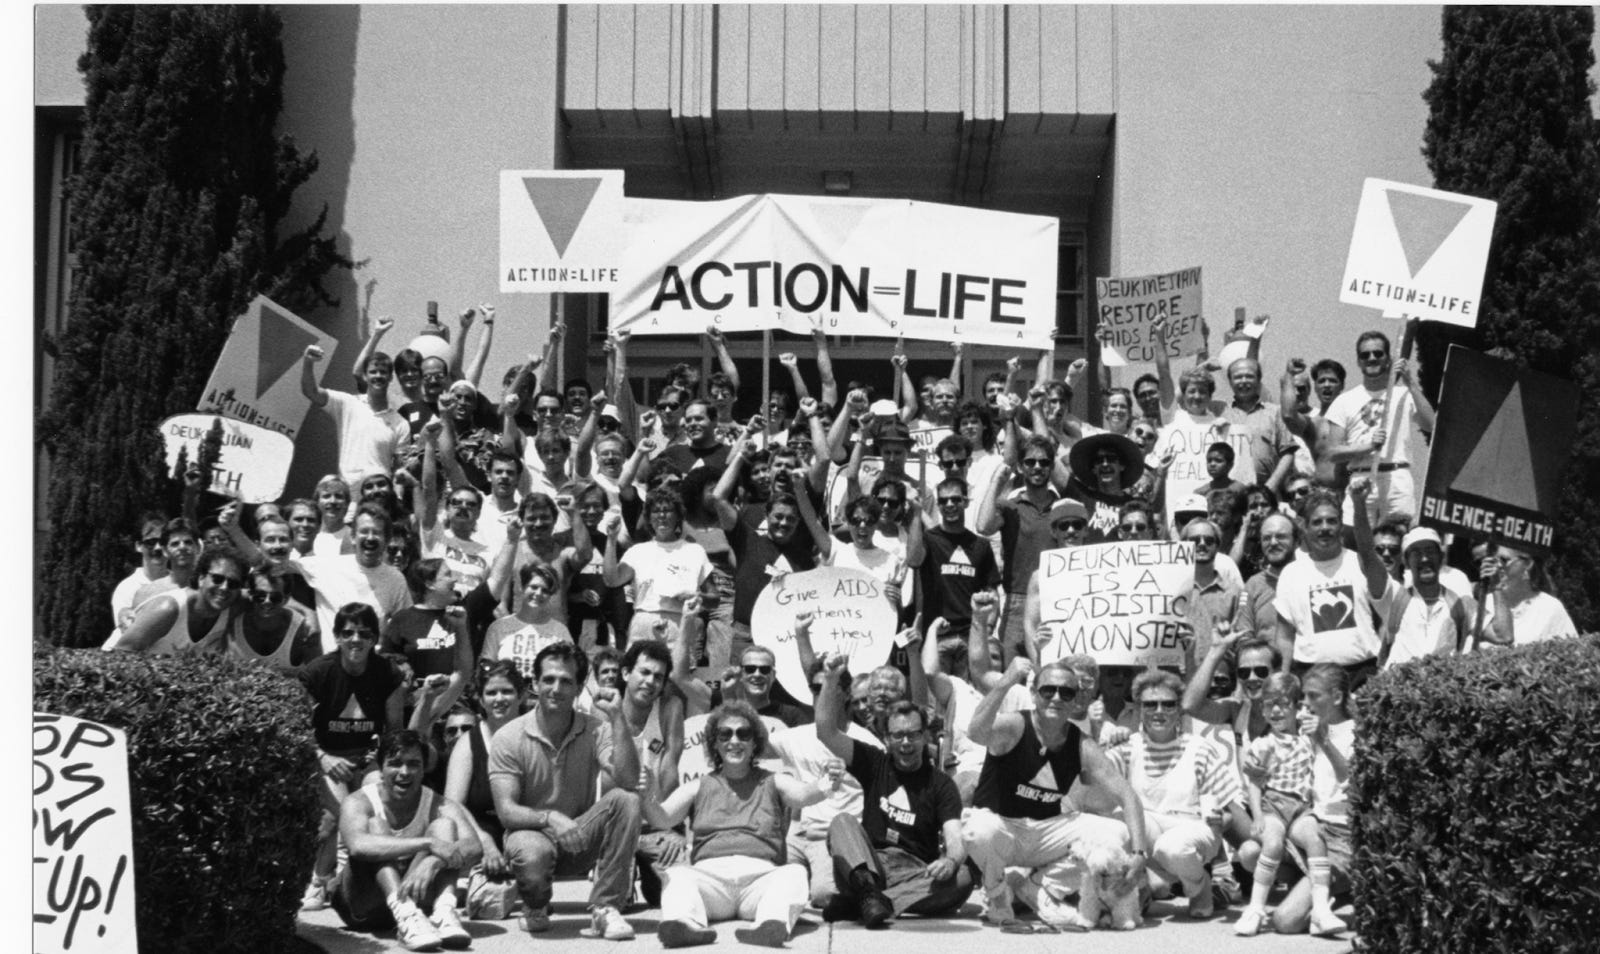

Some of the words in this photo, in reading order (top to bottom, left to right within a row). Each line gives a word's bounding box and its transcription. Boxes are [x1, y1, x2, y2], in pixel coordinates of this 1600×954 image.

[506, 267, 619, 282] ACTION=LIFE
[1097, 268, 1202, 299] DEUKMEJIAN
[650, 260, 1027, 325] ACTION=LIFE
[1348, 277, 1473, 315] ACTION=LIFE
[1101, 294, 1182, 327] RESTORE
[1103, 328, 1141, 349] AIDS
[1126, 339, 1181, 362] CUS
[170, 423, 254, 449] DEUKJIAN
[1423, 495, 1554, 547] SILENCE=DEATH
[1047, 541, 1196, 578] DEUKMEJIAN
[775, 587, 820, 606] Give
[833, 578, 880, 599] AIDS
[1081, 571, 1121, 597] IS
[1133, 568, 1162, 593] A
[812, 604, 864, 620] tients
[1040, 593, 1188, 626] SADISTIC
[829, 626, 875, 649] they
